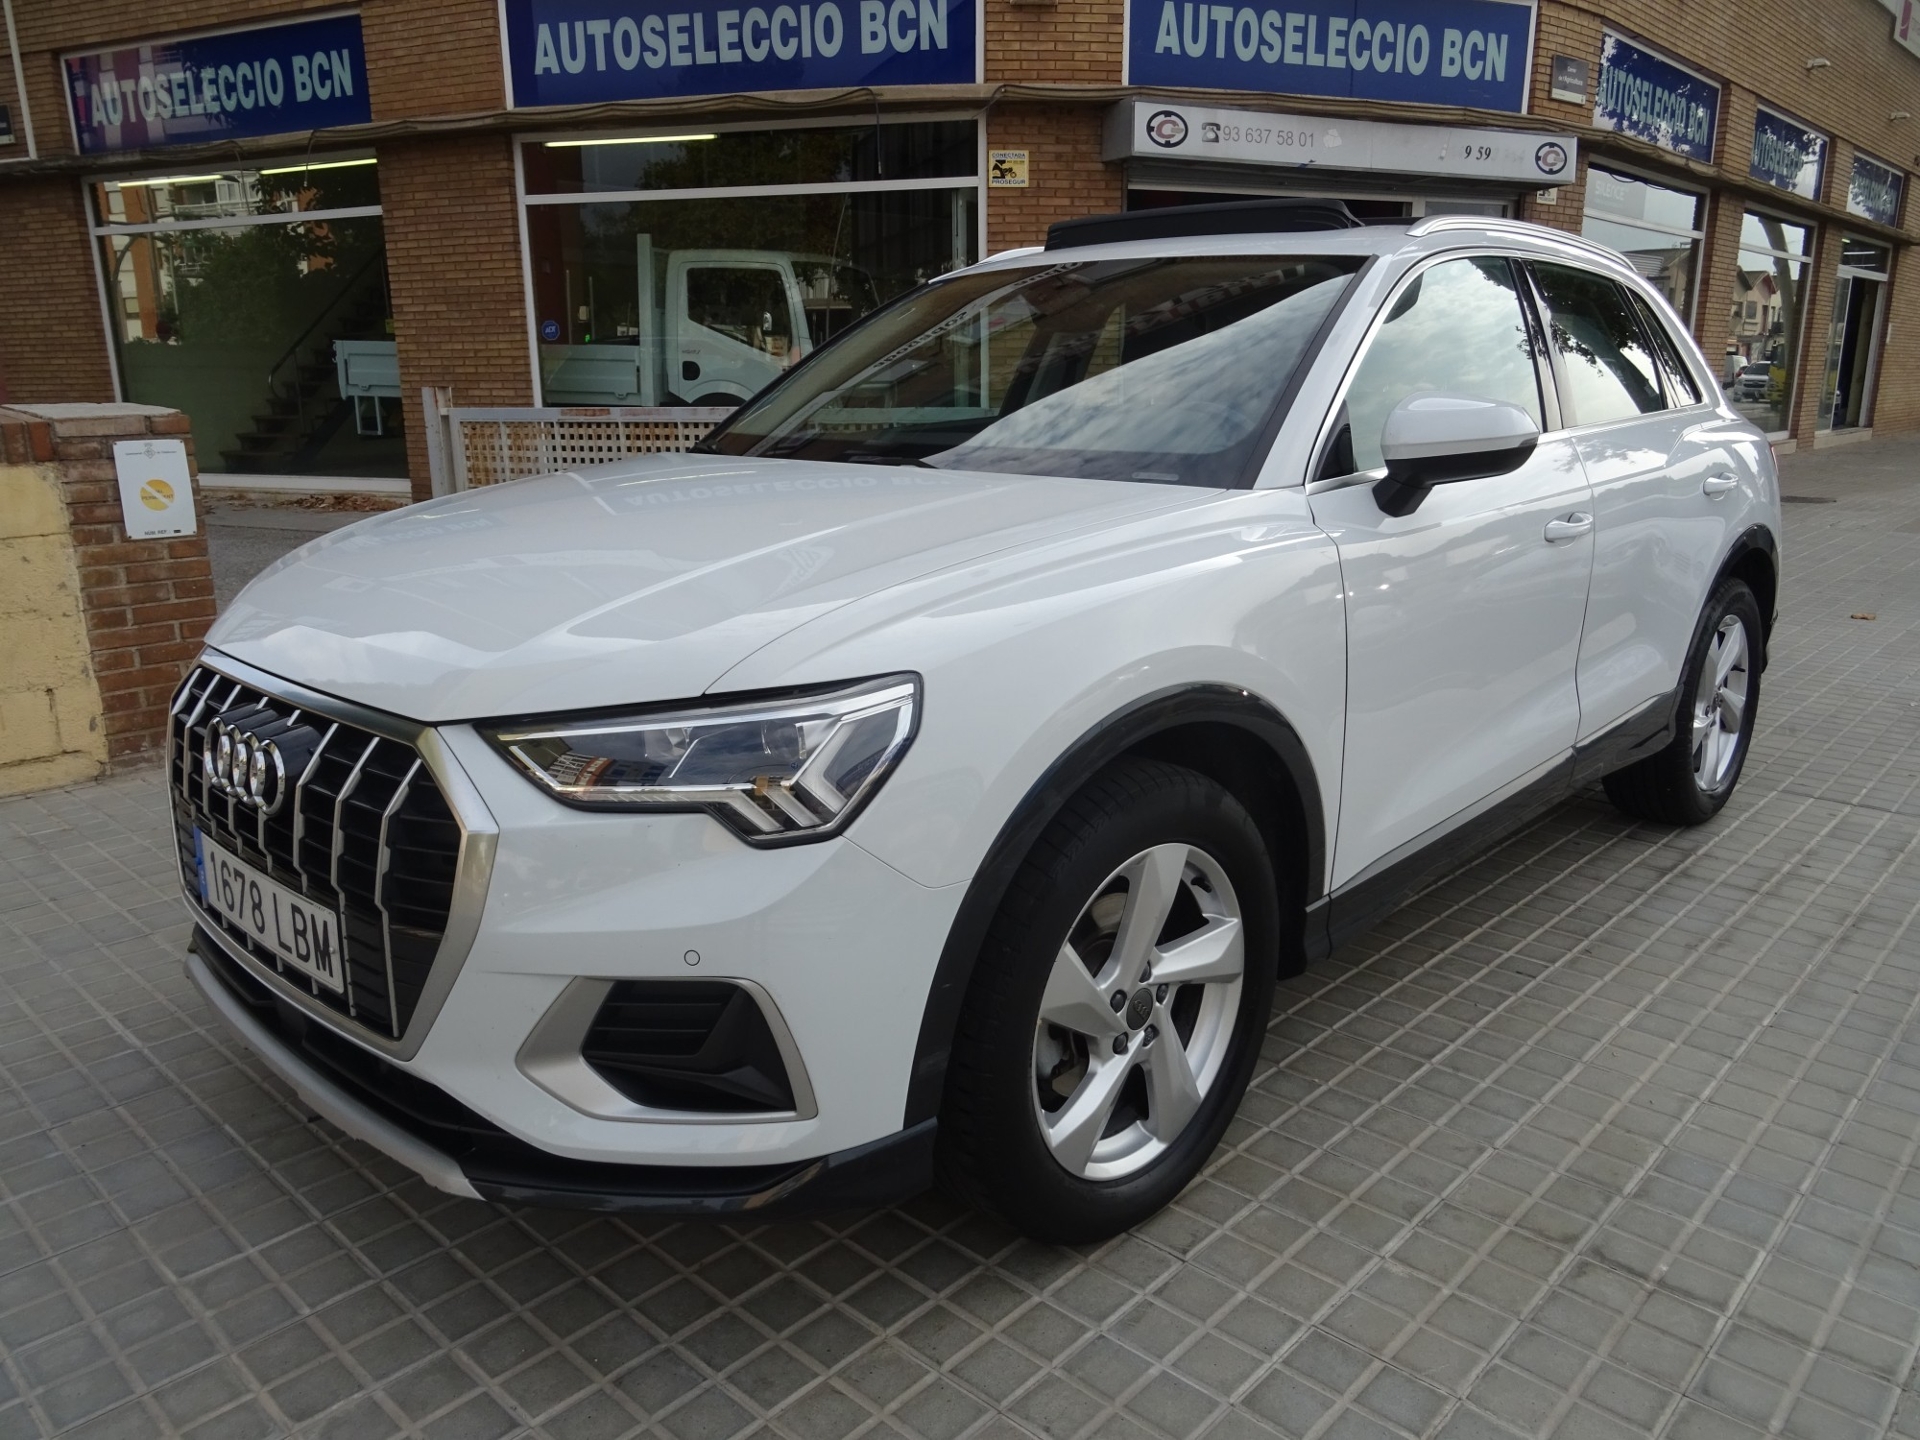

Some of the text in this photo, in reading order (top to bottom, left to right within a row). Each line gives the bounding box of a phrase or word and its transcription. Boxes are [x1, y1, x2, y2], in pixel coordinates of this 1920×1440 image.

[534, 0, 949, 76] AUTOSELECCIO BCN
[1155, 1, 1508, 82] AUTOSELECCIO BCN
[91, 49, 354, 127] AUTOSELECCIO BCN
[1596, 66, 1711, 146] AUTOSELECCIO BCN
[1223, 125, 1314, 148] 93 637 58 01
[210, 851, 334, 978] 1678 LBM
